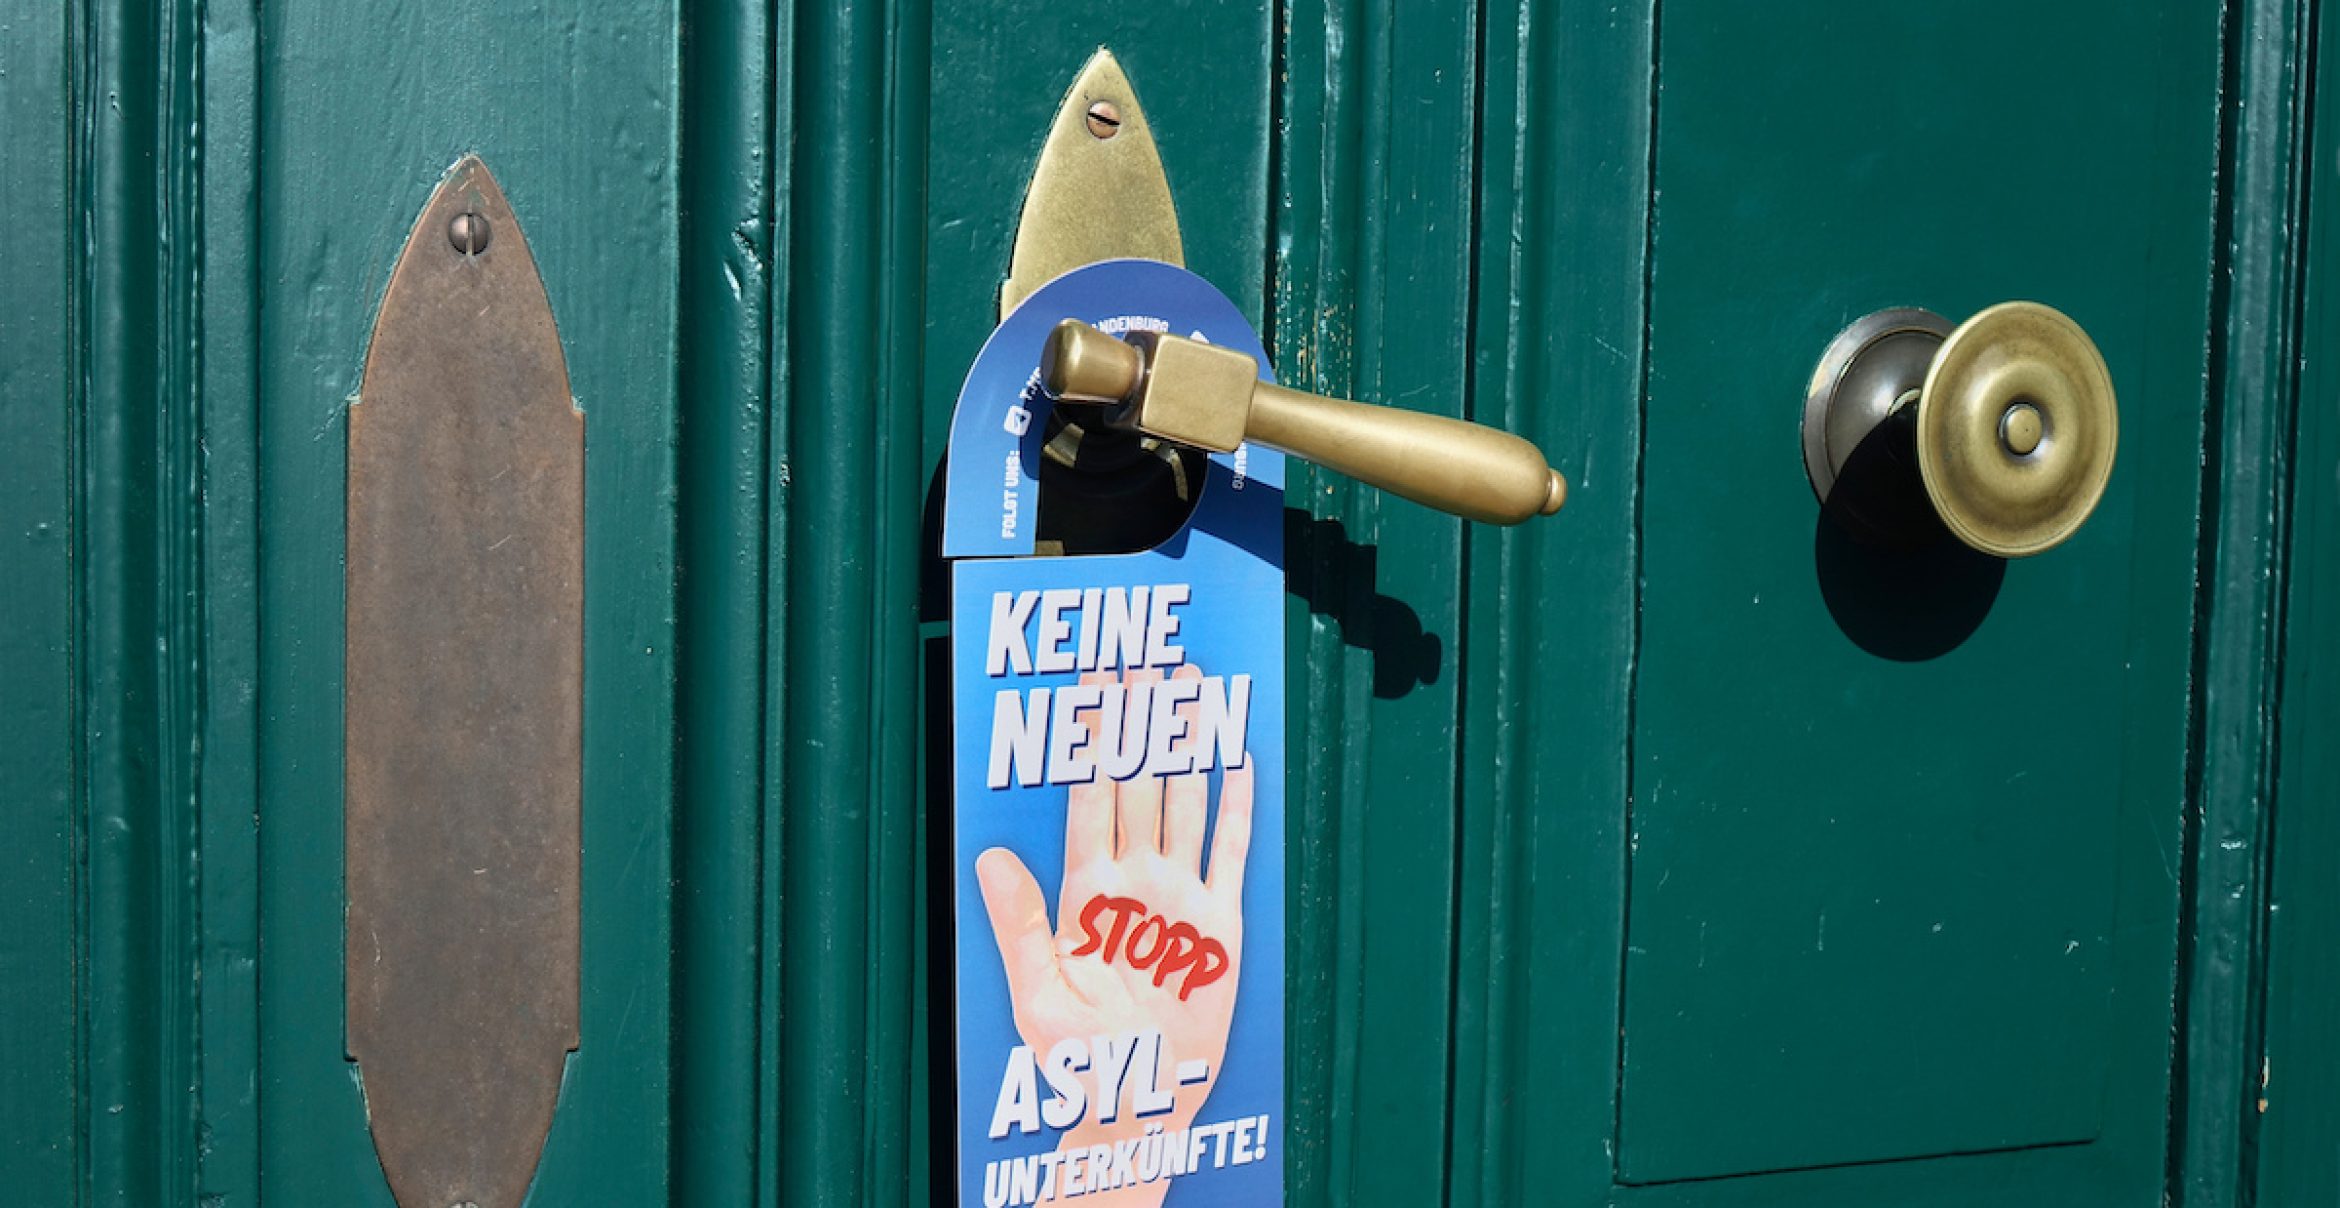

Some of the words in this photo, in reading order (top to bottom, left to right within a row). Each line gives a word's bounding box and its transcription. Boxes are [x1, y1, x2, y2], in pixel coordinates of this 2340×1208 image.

[987, 584, 1191, 677] KEINE
[987, 674, 1252, 790] NEUEN
[1071, 893, 1230, 1002] STOPP
[988, 1031, 1210, 1140] ASYL-
[983, 1114, 1269, 1208] UNTERKÜNFTE!
